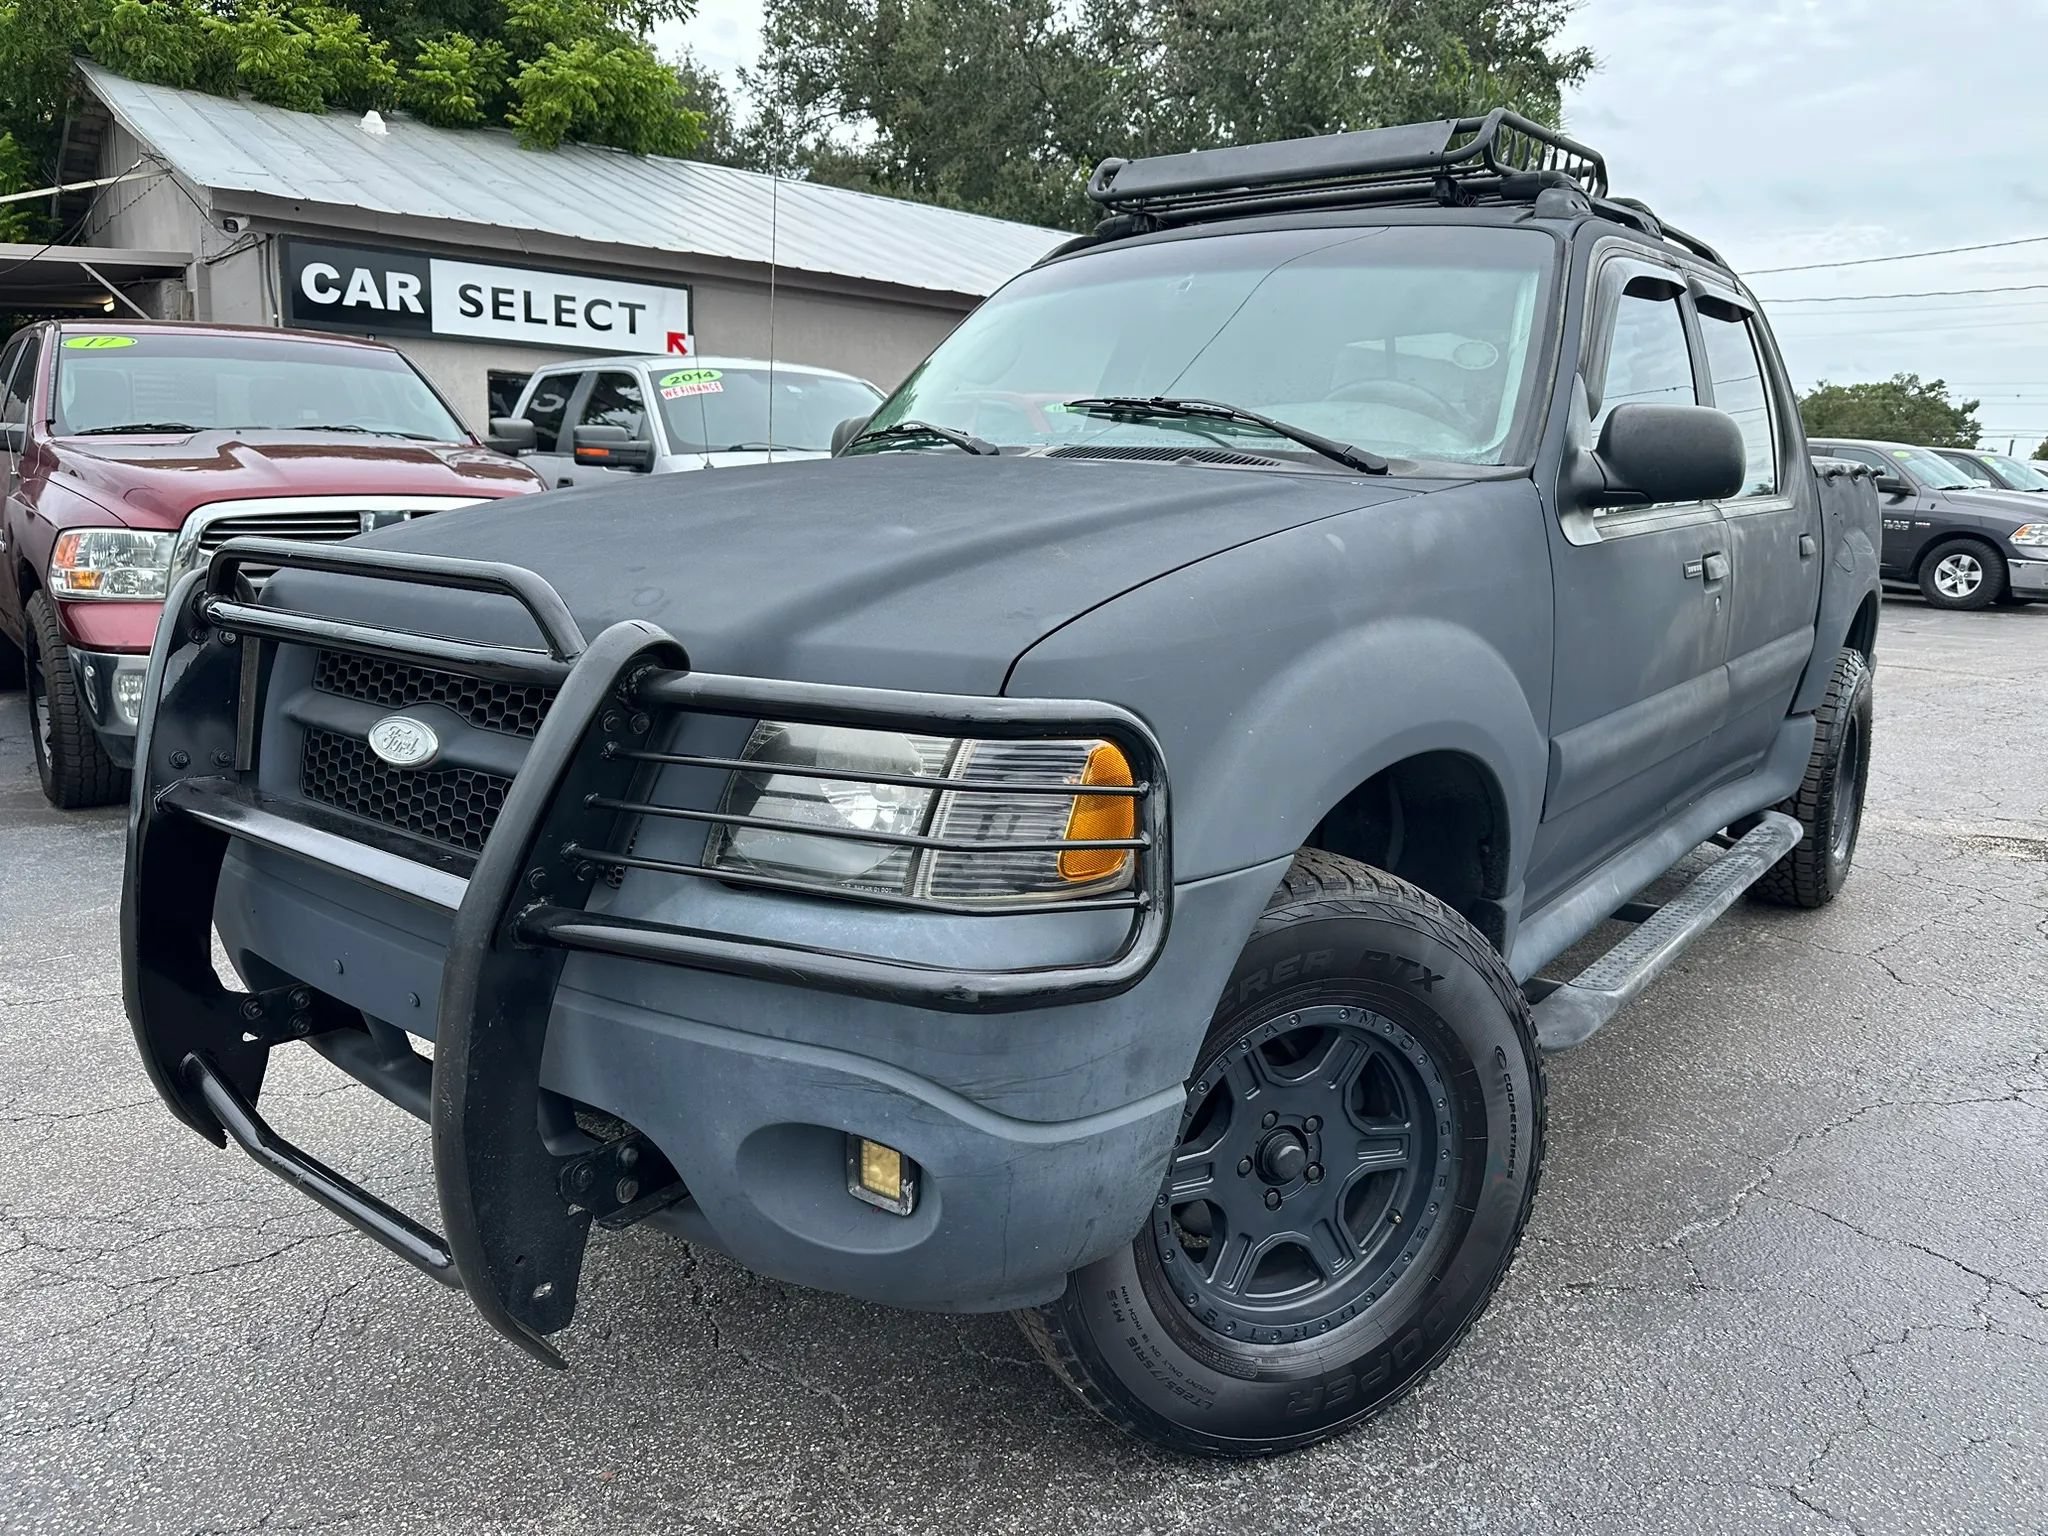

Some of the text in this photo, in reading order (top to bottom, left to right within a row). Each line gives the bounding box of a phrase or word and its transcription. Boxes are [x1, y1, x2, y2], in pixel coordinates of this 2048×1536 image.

[301, 262, 647, 335] CAR SELECT
[84, 337, 117, 347] 17
[669, 371, 714, 385] 2014
[663, 382, 721, 398] WE FINANCE
[384, 725, 419, 755] Ford
[1107, 1290, 1125, 1323] M+S
